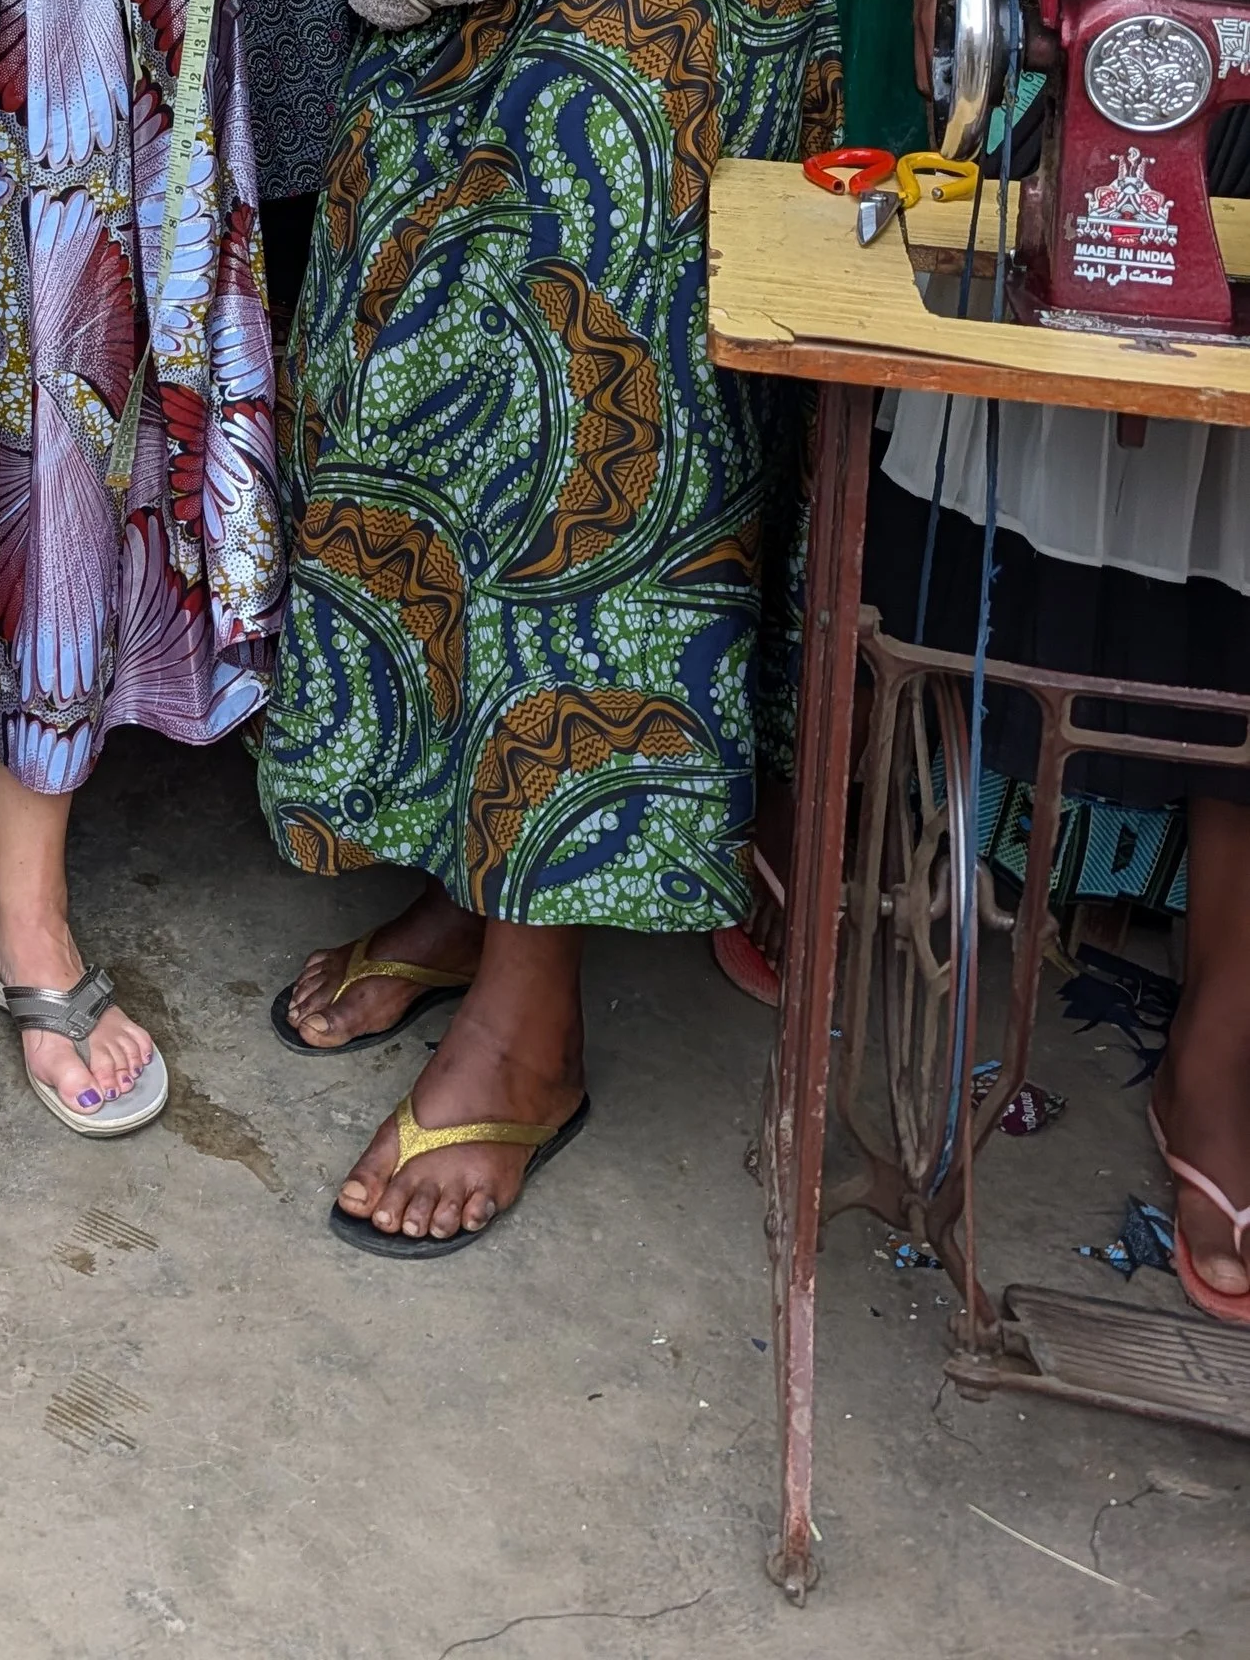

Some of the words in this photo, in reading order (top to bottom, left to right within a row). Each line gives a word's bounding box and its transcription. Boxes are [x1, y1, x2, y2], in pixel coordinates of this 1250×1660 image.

[198, 5, 211, 25] 14
[188, 72, 201, 92] 12
[184, 107, 197, 126] 11
[180, 140, 192, 160] 10
[1075, 243, 1116, 259] MADE
[1119, 248, 1134, 261] IN
[1137, 250, 1175, 265] INDIA
[1074, 262, 1106, 282] الهند
[1107, 265, 1128, 286] في
